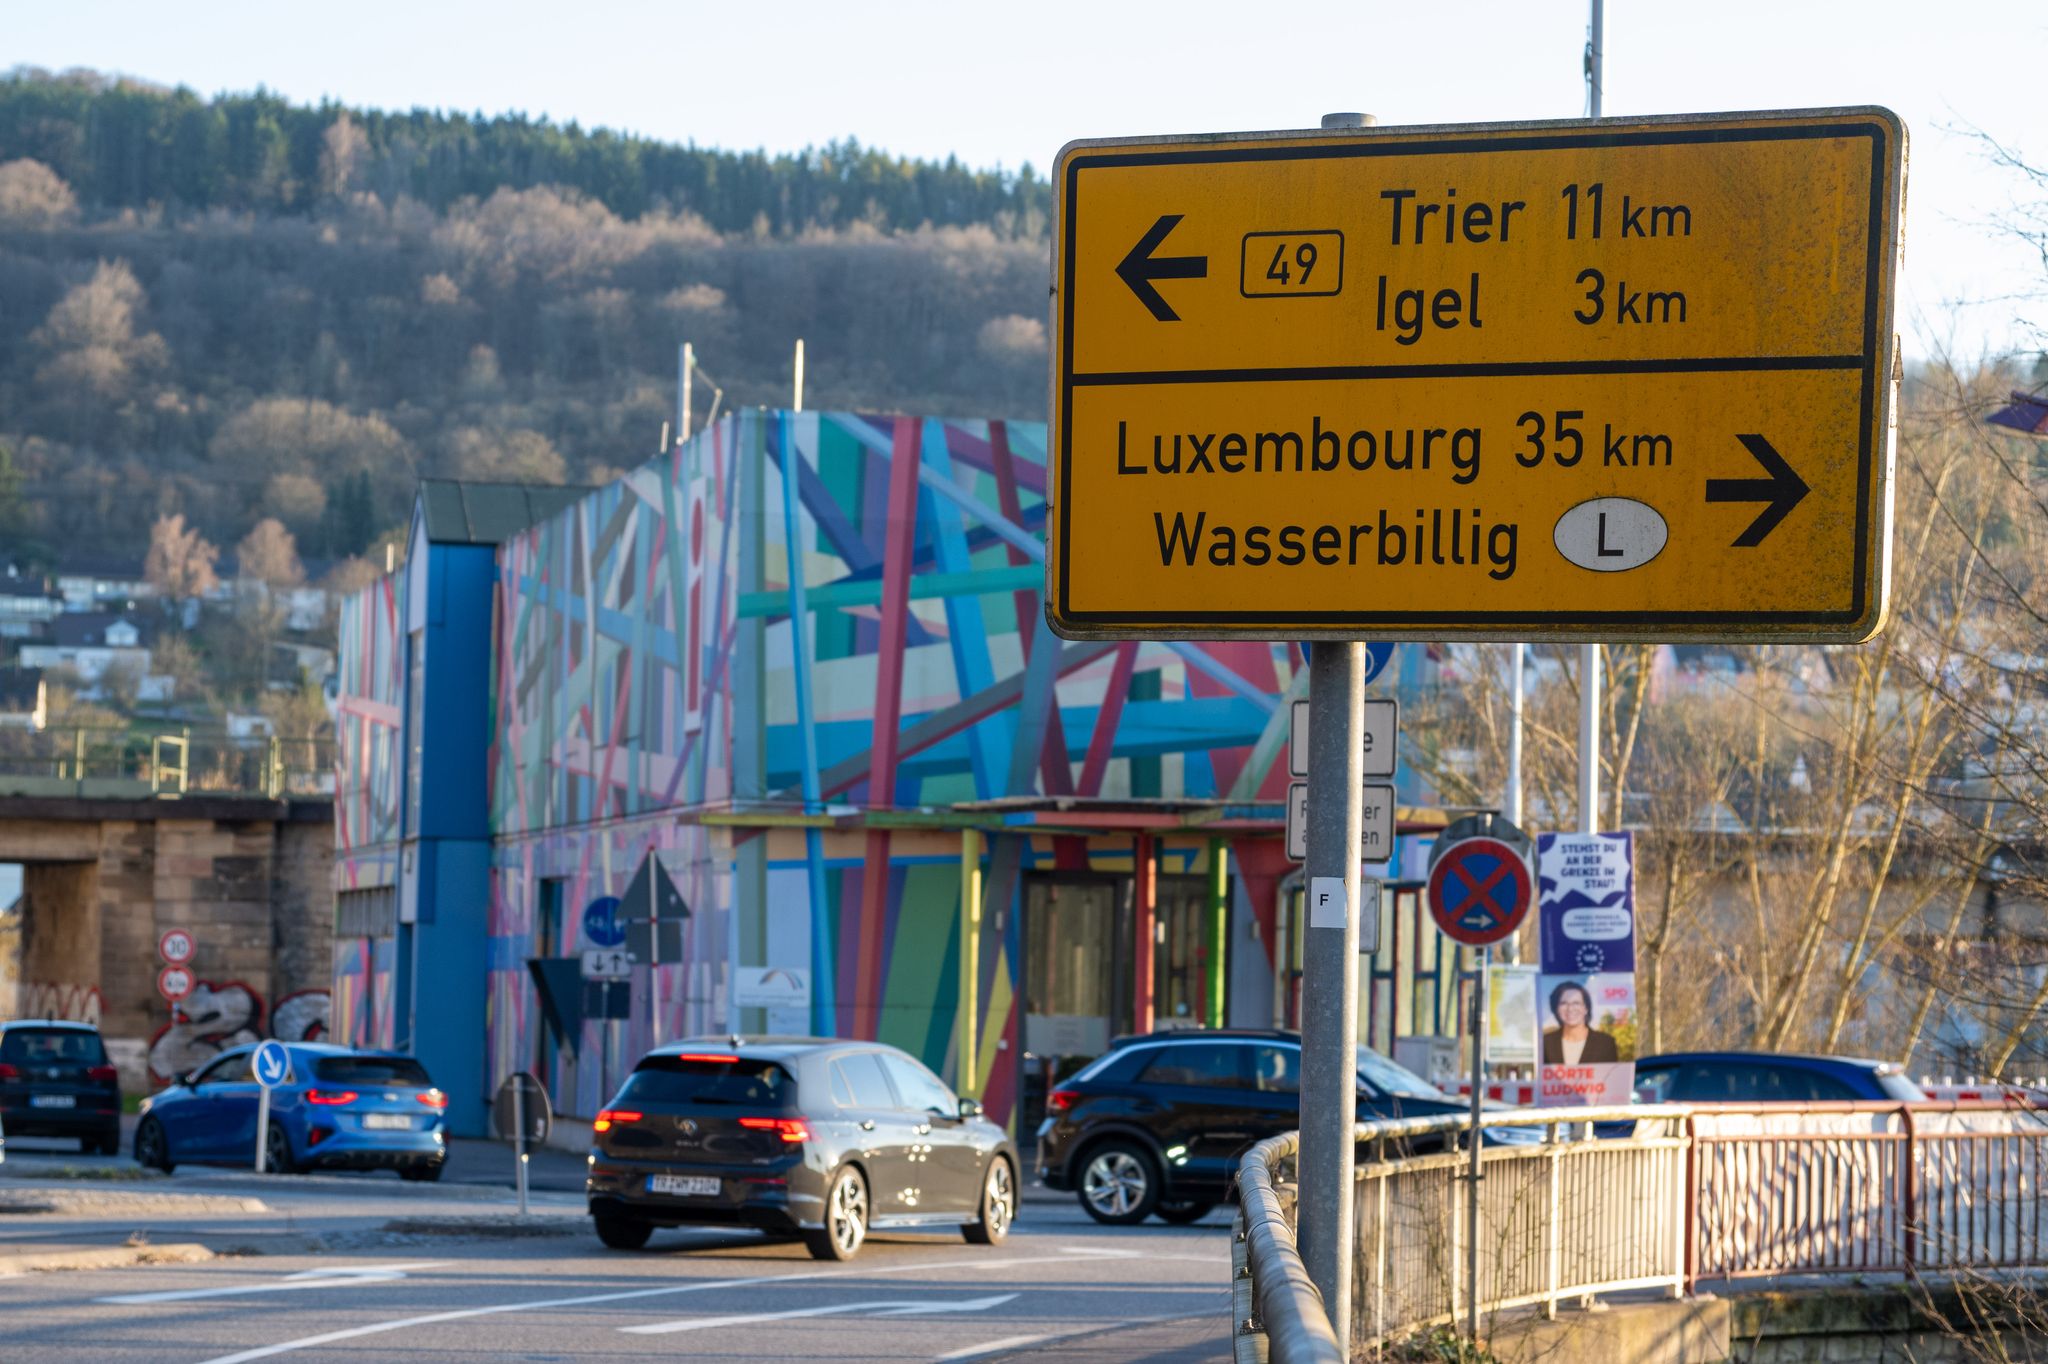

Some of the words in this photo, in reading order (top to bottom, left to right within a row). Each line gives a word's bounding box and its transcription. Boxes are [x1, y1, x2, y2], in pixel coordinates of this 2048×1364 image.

[1381, 189, 1526, 245] Trier
[1563, 183, 1603, 239] 11
[1622, 196, 1691, 238] km
[1266, 243, 1318, 286] 49
[1377, 273, 1482, 345] Igel
[1574, 268, 1605, 325] 3
[1618, 282, 1686, 324] km
[1118, 417, 1481, 484] Luxembourg
[1516, 411, 1583, 468] 35
[1604, 424, 1672, 466] km
[1598, 513, 1623, 556] L
[1154, 509, 1517, 580] Wasserbillig
[1561, 844, 1600, 853] STEHST
[1604, 843, 1616, 852] DU
[1566, 856, 1579, 864] AN
[1583, 856, 1601, 864] DER
[1561, 868, 1600, 876] GRENZE
[1584, 879, 1615, 888] STAU?
[1320, 894, 1329, 906] F
[1605, 988, 1628, 999] SPD
[1543, 1065, 1594, 1080] DÖRTE
[1543, 1083, 1605, 1096] LUDWIG
